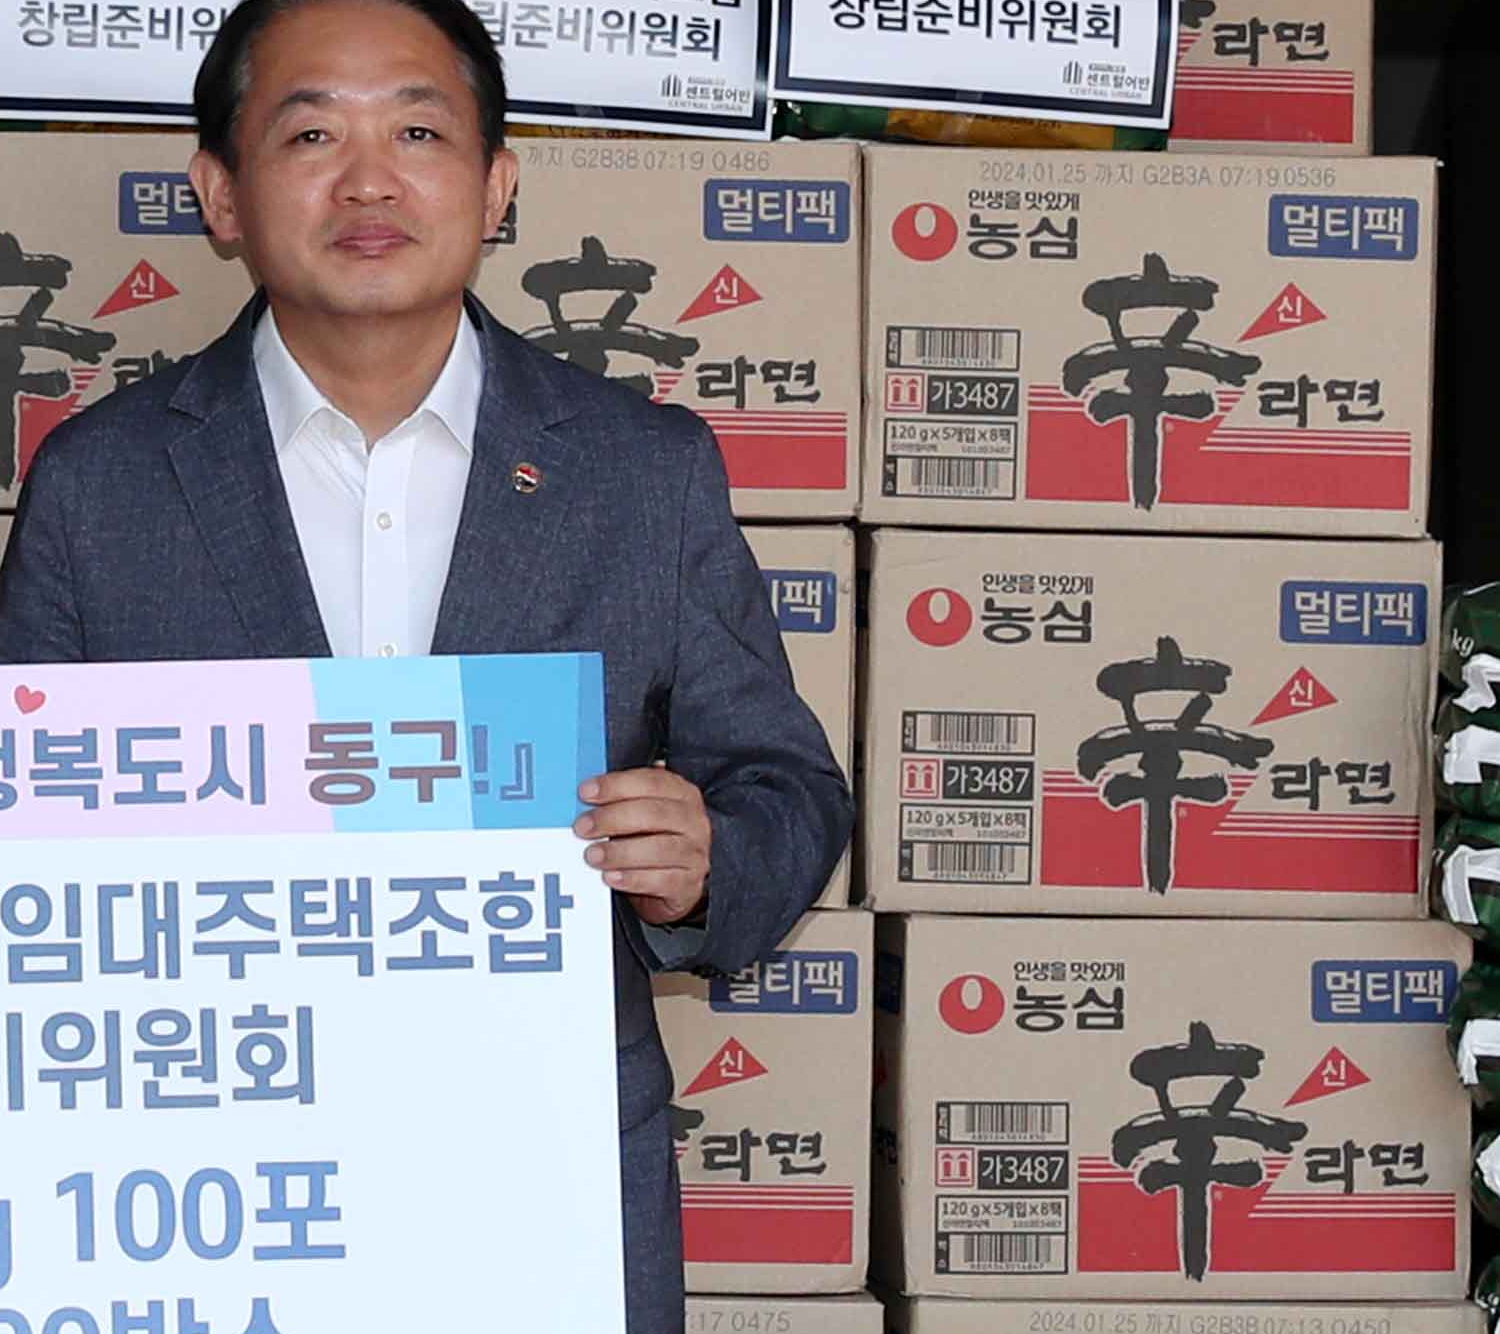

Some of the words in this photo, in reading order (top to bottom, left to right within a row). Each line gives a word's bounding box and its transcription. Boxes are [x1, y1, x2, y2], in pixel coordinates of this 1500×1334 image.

[18, 1, 225, 50] 창립준비위
[472, 0, 721, 61] 립준비위원회
[1213, 19, 1330, 65] 라면
[717, 188, 837, 234] 멀티팩
[967, 190, 1022, 211] 인생을
[1024, 190, 1080, 212] 맛있게
[966, 214, 1079, 260] 농심
[1281, 204, 1404, 251] 멀티팩
[714, 276, 739, 303] 신
[1277, 295, 1302, 322] 신
[696, 355, 821, 408] 라면
[931, 381, 1014, 411] 가3487
[1062, 253, 1262, 511] 辛
[1257, 375, 1384, 428] 라면
[981, 599, 1092, 644] 농심
[1294, 590, 1414, 636] 멀티팩
[304, 720, 535, 806] 동구!』
[947, 765, 1029, 794] 가3487
[1271, 757, 1395, 810] 라면
[1014, 986, 1124, 1033] 농심
[1325, 969, 1445, 1015] 멀티팩
[981, 1154, 1064, 1184] 가3487
[1112, 1020, 1307, 1283] 辛
[1305, 1141, 1429, 1194] 라면
[56, 1161, 346, 1262] 100포
